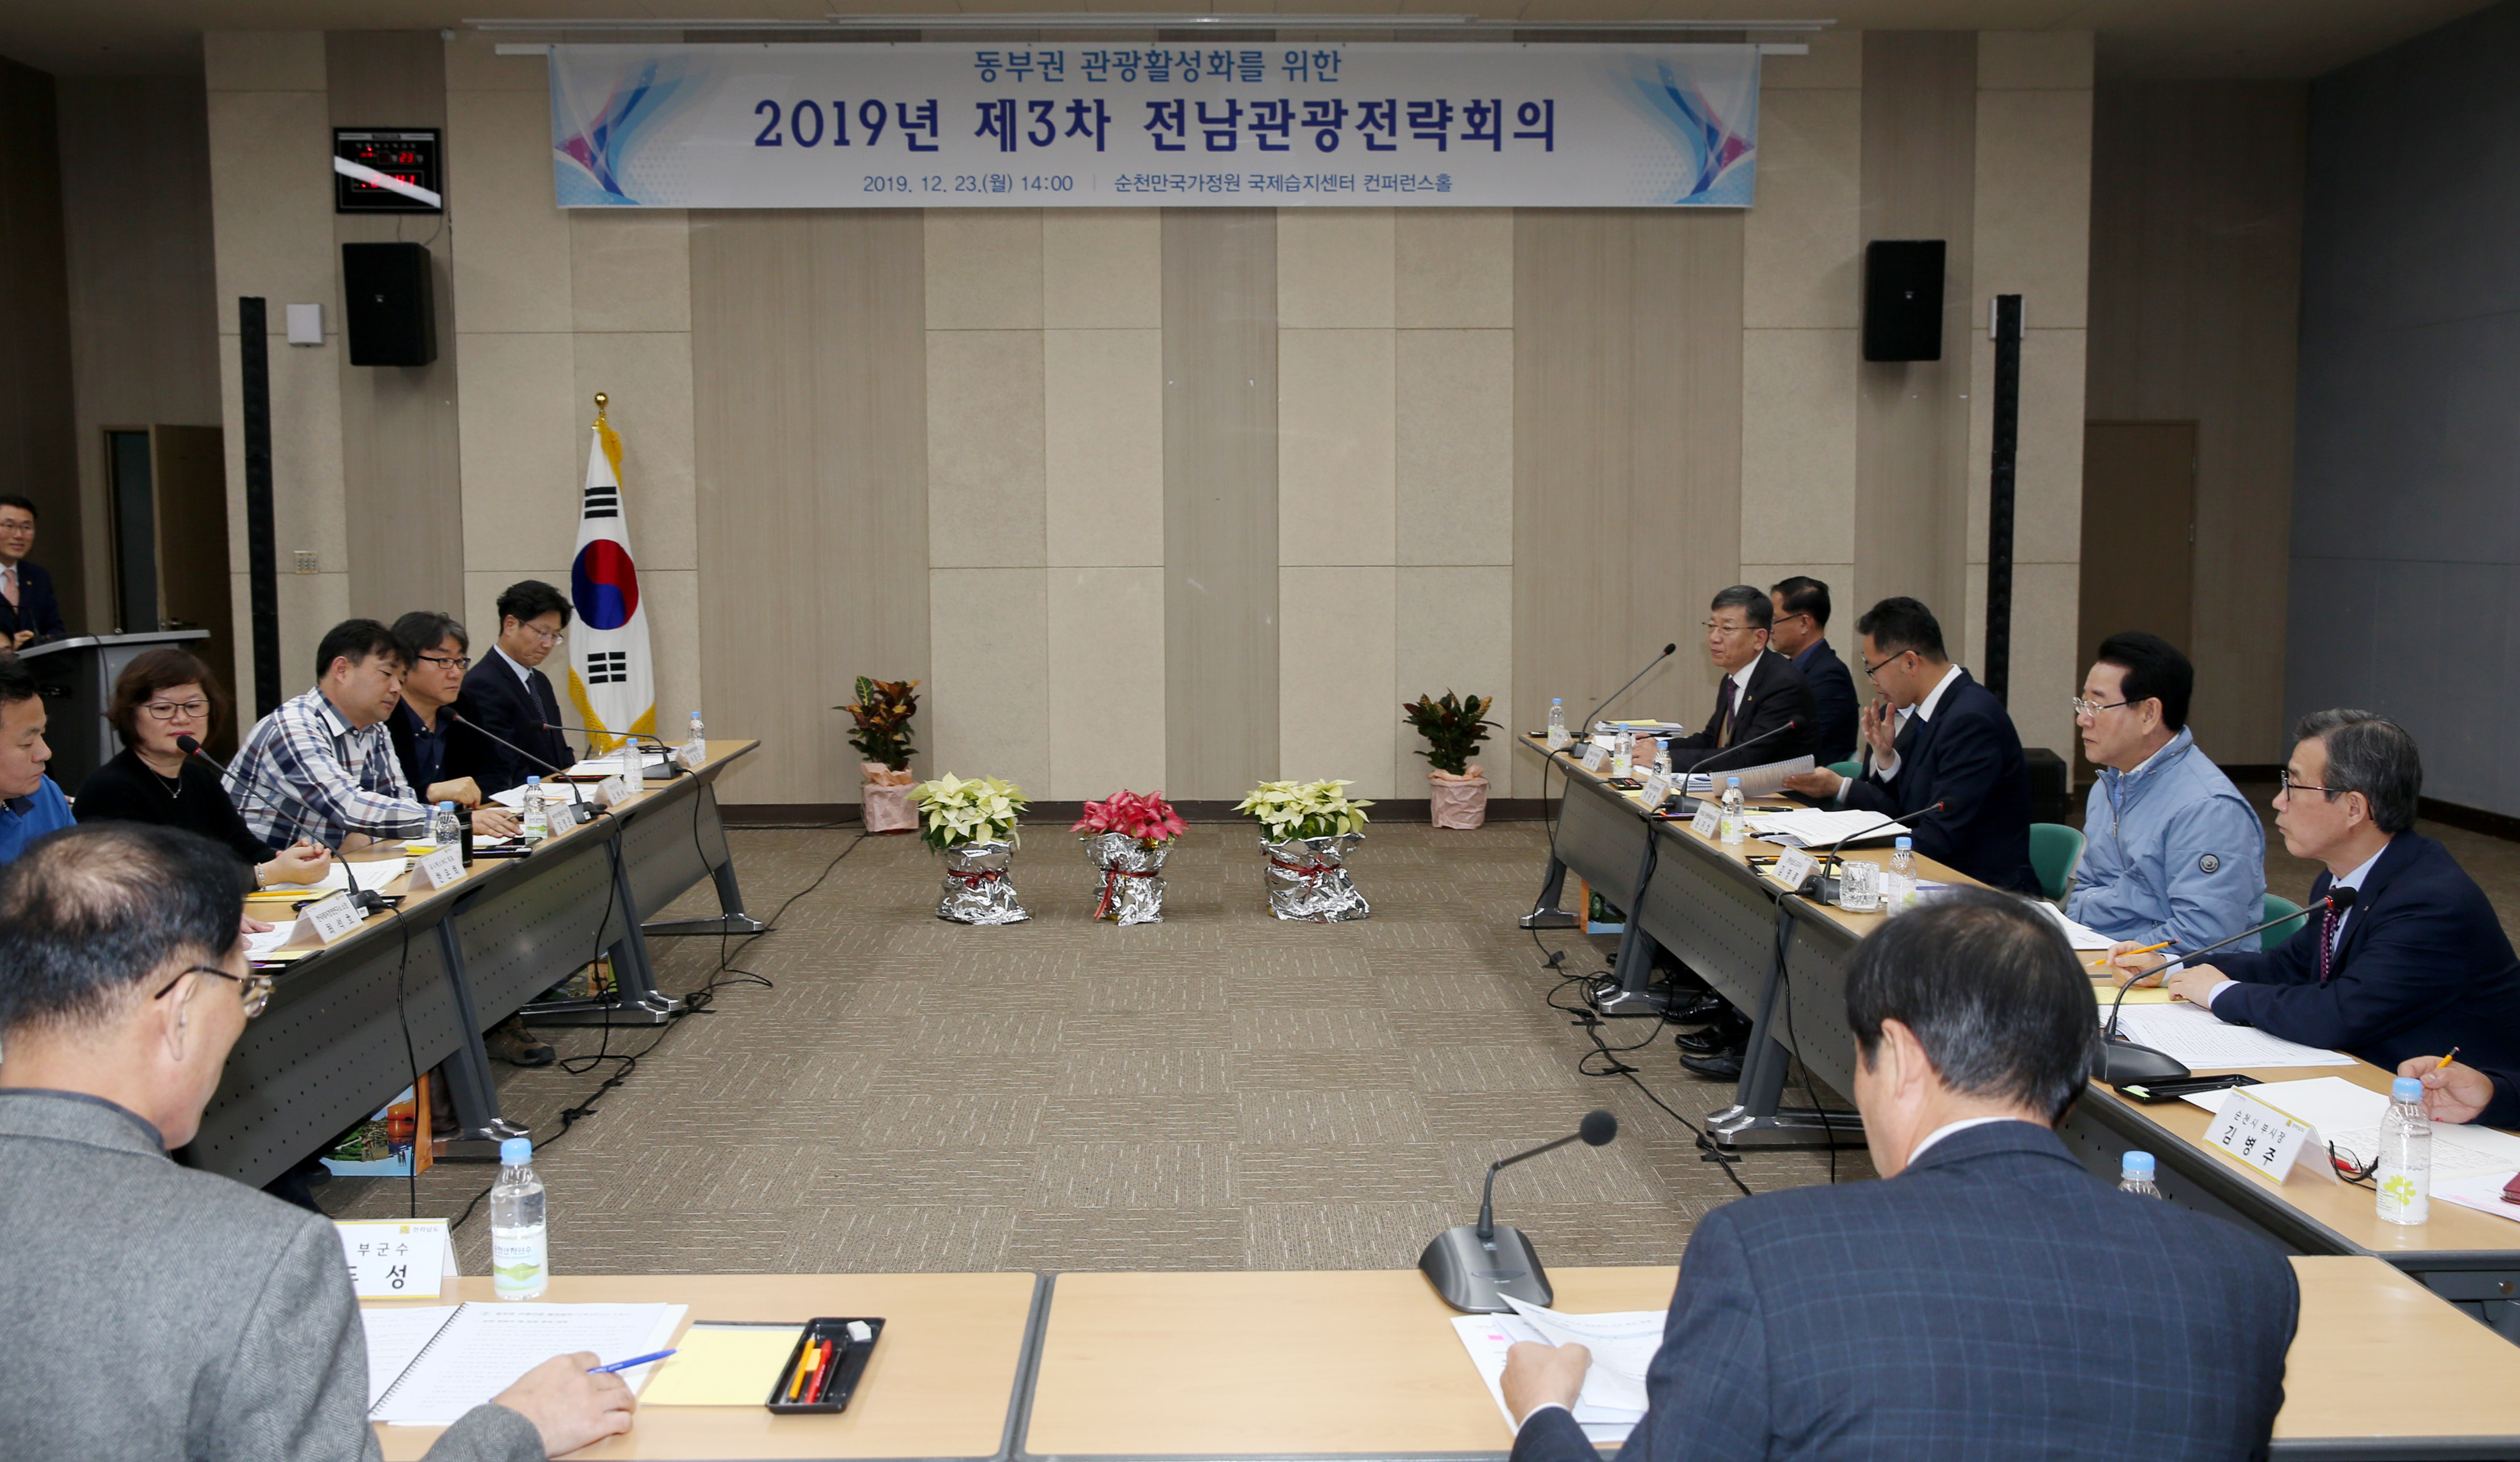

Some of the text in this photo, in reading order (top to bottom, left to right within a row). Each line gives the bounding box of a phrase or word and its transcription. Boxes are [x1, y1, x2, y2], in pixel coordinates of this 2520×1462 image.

[974, 49, 1342, 83] 동부권 관광활성화를 위한
[754, 98, 1555, 153] 2019년 제3차 전남관광전략회의
[863, 173, 1452, 193] 2019. 12. 23.(월) 14:00 순천만국가정원 국제습지센터 컨퍼런스홀
[2260, 1122, 2286, 1144] 부시장
[357, 1243, 409, 1257] 부군수
